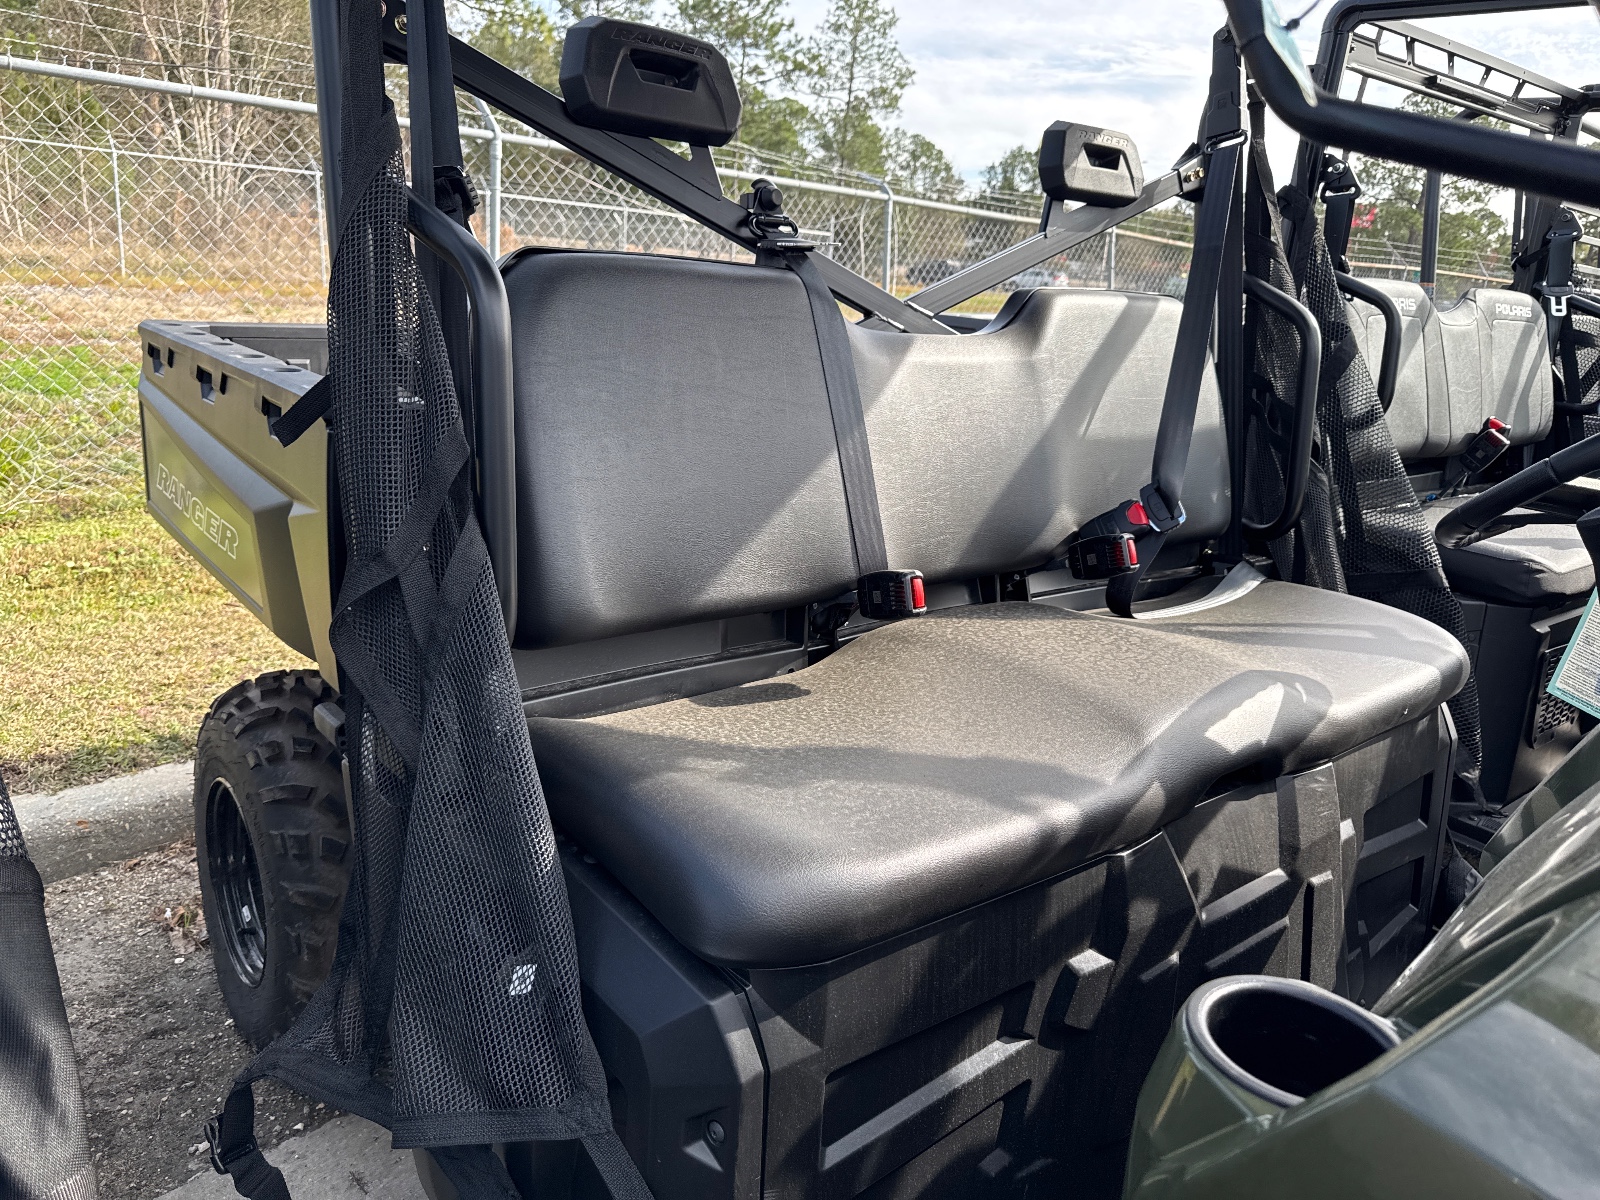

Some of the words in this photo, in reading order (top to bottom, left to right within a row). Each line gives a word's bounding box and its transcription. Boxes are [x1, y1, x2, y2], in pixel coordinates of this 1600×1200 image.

[610, 27, 713, 60] RANGER
[1079, 129, 1128, 147] RANGER
[1495, 303, 1532, 317] POLARIS
[156, 462, 239, 560] RANGER
